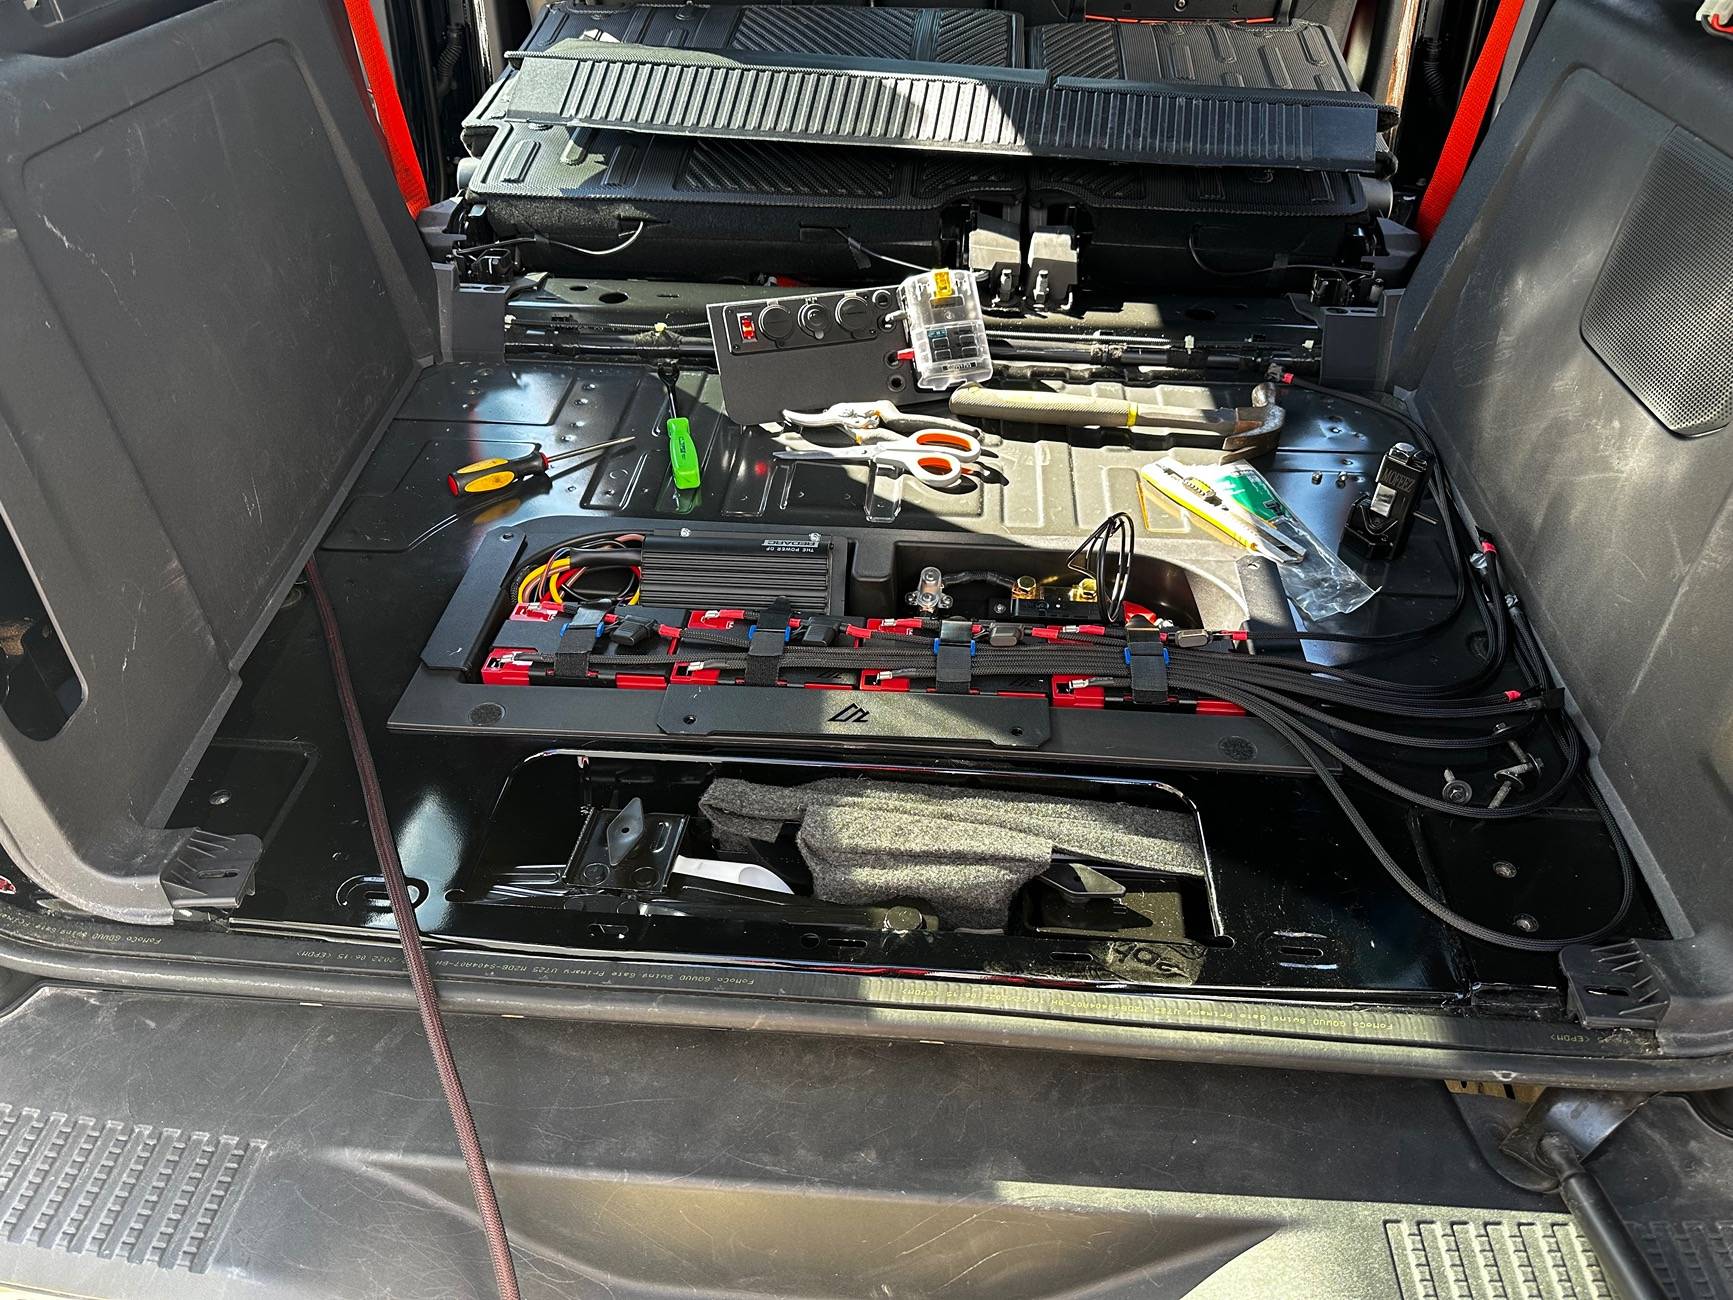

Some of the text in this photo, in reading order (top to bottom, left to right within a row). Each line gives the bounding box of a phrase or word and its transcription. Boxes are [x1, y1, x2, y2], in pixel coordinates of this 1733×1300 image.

[1382, 469, 1416, 493] MOFEEZ
[126, 935, 162, 945] FoMoCo
[533, 966, 557, 974] U725
[717, 977, 754, 985] FoMoCo
[1188, 1010, 1232, 1018] Primary
[1240, 1013, 1266, 1021] Gate
[1273, 1016, 1305, 1024] Swing
[1353, 1021, 1392, 1030] FoMoCo
[1550, 1034, 1590, 1042] <EPDM>
